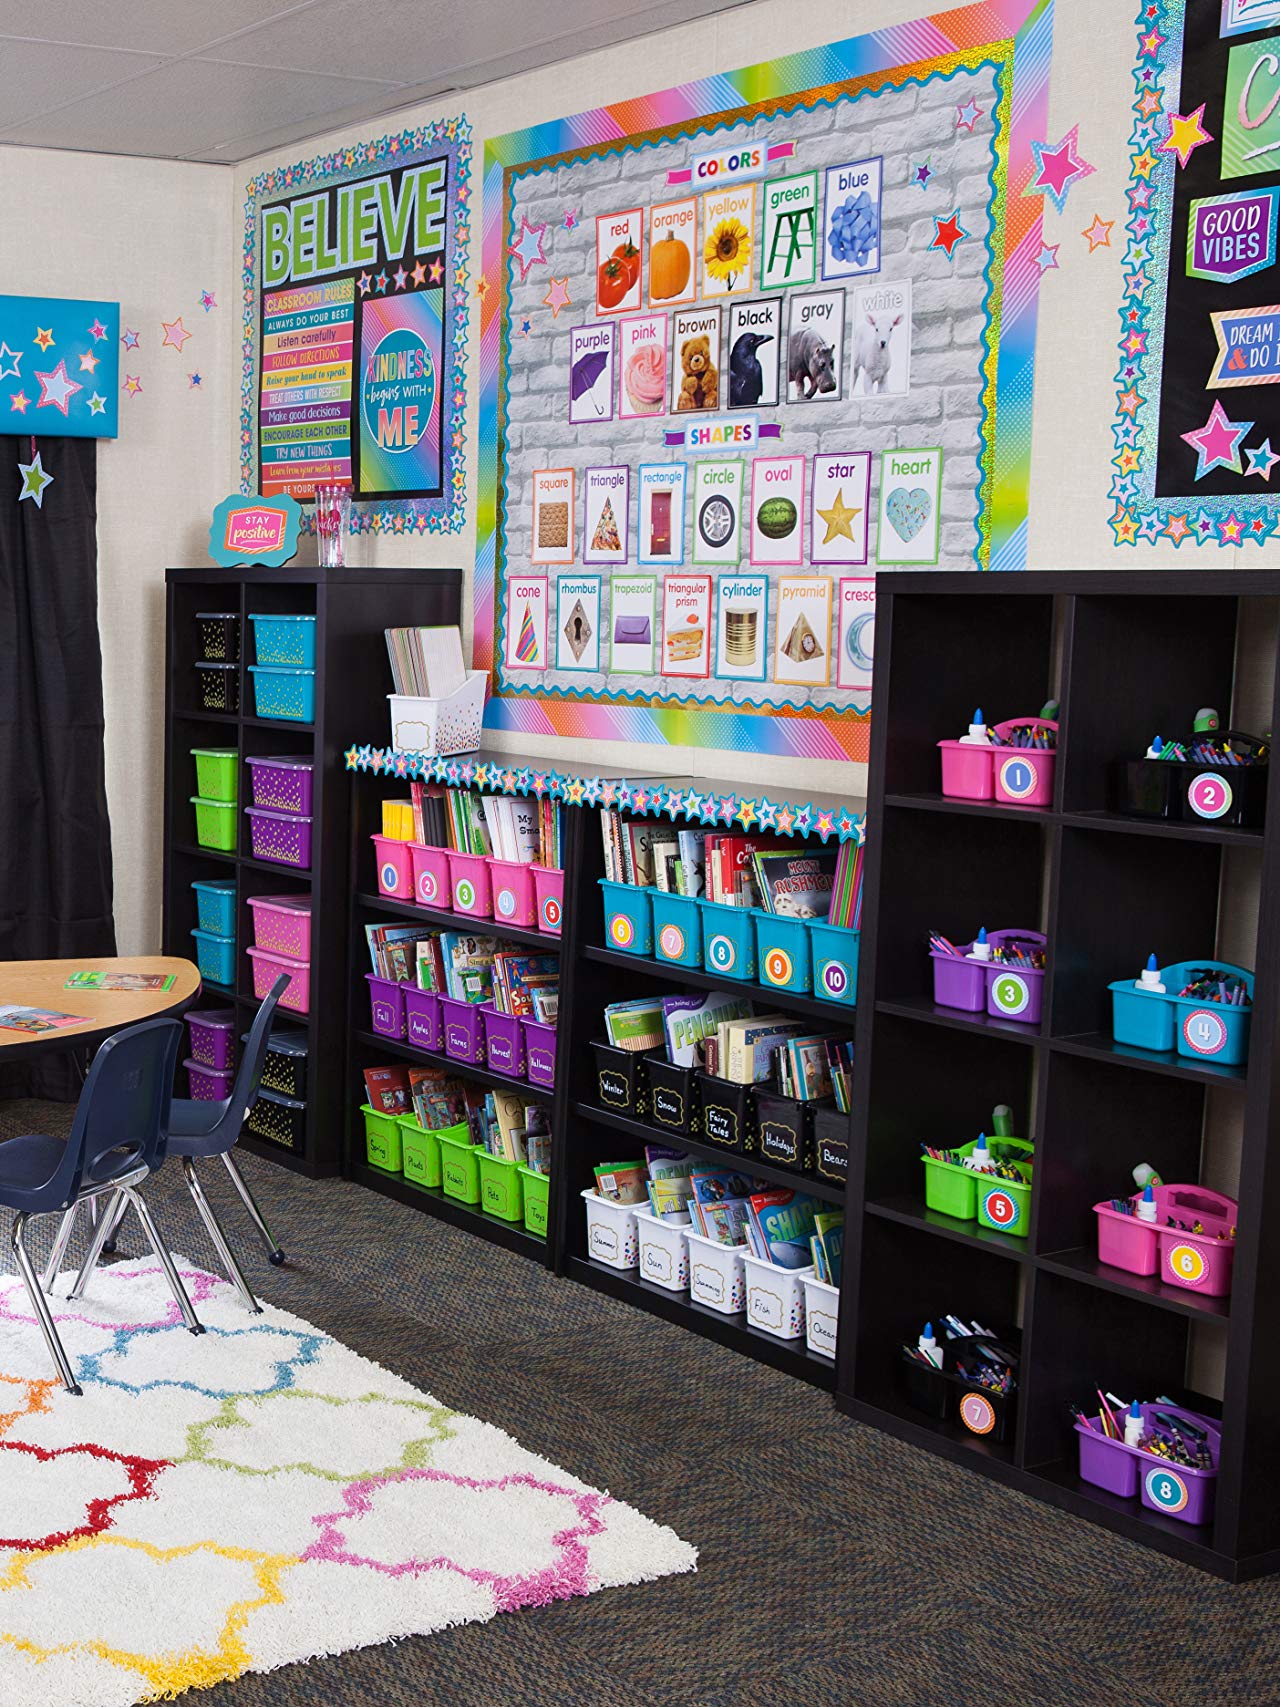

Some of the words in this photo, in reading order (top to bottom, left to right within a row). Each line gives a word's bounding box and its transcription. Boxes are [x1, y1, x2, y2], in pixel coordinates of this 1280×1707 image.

[698, 149, 760, 178] COLORS
[838, 171, 869, 191] blue
[771, 184, 810, 208] green
[708, 196, 750, 217] yellow
[262, 159, 448, 288] BELIEVE
[610, 218, 630, 236] red
[653, 208, 694, 230] orange
[1202, 205, 1261, 237] GOOD
[1202, 232, 1260, 264] VIBES
[266, 290, 322, 312] CLASSROOM
[324, 284, 352, 301] RULES
[862, 289, 903, 311] white
[738, 306, 773, 327] black
[801, 301, 834, 321] gray
[268, 318, 294, 331] ALWAYS
[296, 316, 307, 325] DO
[310, 312, 329, 323] YOUR
[332, 309, 349, 319] BEST
[678, 315, 717, 335] brown
[277, 336, 299, 348] Listen
[301, 329, 336, 344] carefully
[631, 323, 657, 343] pink
[1231, 323, 1274, 346] DREAM
[575, 331, 610, 353] purple
[272, 353, 297, 368] FOLLOW
[300, 346, 340, 364] DIRECTIONS
[367, 348, 433, 383] KINDNESS
[1227, 348, 1248, 371] &
[1250, 345, 1270, 368] DO
[284, 373, 299, 384] your
[301, 370, 317, 381] hand
[319, 370, 325, 378] to
[326, 366, 347, 379] speak
[305, 388, 318, 400] WITH
[319, 386, 341, 398] RESPECT
[370, 385, 400, 407] begins
[402, 384, 427, 398] WITH
[268, 412, 287, 423] Make
[289, 408, 307, 423] good
[307, 406, 341, 417] decisions
[264, 430, 303, 442] ENCOURAGE
[305, 427, 323, 438] EACH
[324, 424, 347, 436] OTHER
[377, 405, 419, 448] ME
[690, 423, 752, 446] SHAPES
[276, 447, 288, 459] TRY
[290, 446, 306, 458] NEW
[307, 443, 333, 457] THINGS
[765, 464, 793, 482] oval
[827, 463, 856, 479] star
[891, 458, 932, 476] heart
[539, 477, 569, 490] square
[590, 472, 625, 489] triangle
[644, 470, 682, 484] rectangle
[703, 468, 735, 485] circle
[245, 516, 270, 524] STAY
[233, 525, 276, 544] positive
[516, 585, 541, 598] cone
[561, 582, 597, 594] rhombus
[615, 583, 652, 596] trapezoid
[668, 582, 707, 596] triangular
[722, 582, 763, 598] cylinder
[782, 585, 826, 600] pyramid
[675, 597, 698, 608] prism
[1016, 769, 1021, 785] 1
[1203, 787, 1215, 805] 2
[517, 815, 533, 825] My
[788, 860, 820, 875] MOUNT
[387, 871, 391, 882] 1
[425, 880, 431, 892] 2
[462, 889, 468, 900] 3
[503, 896, 509, 908] 4
[549, 906, 555, 920] 5
[618, 925, 625, 938] 6
[669, 935, 675, 949] 7
[718, 947, 725, 960] 8
[774, 960, 781, 974] 9
[829, 972, 841, 988] 10
[1005, 986, 1015, 1002] 3
[377, 1009, 389, 1023] Fall
[1198, 1023, 1210, 1040] 4
[602, 1078, 624, 1096] Winter
[658, 1096, 677, 1113] Snow
[709, 1110, 728, 1128] Fairy
[709, 1123, 729, 1138] Tales
[765, 1132, 794, 1155] Holidays
[996, 1201, 1006, 1217] 5
[593, 1232, 616, 1249] Summer
[646, 1253, 663, 1270] Sun
[1181, 1254, 1193, 1272] 6
[754, 1299, 770, 1315] Fish
[973, 1405, 982, 1422] 7
[1160, 1482, 1172, 1499] 8
